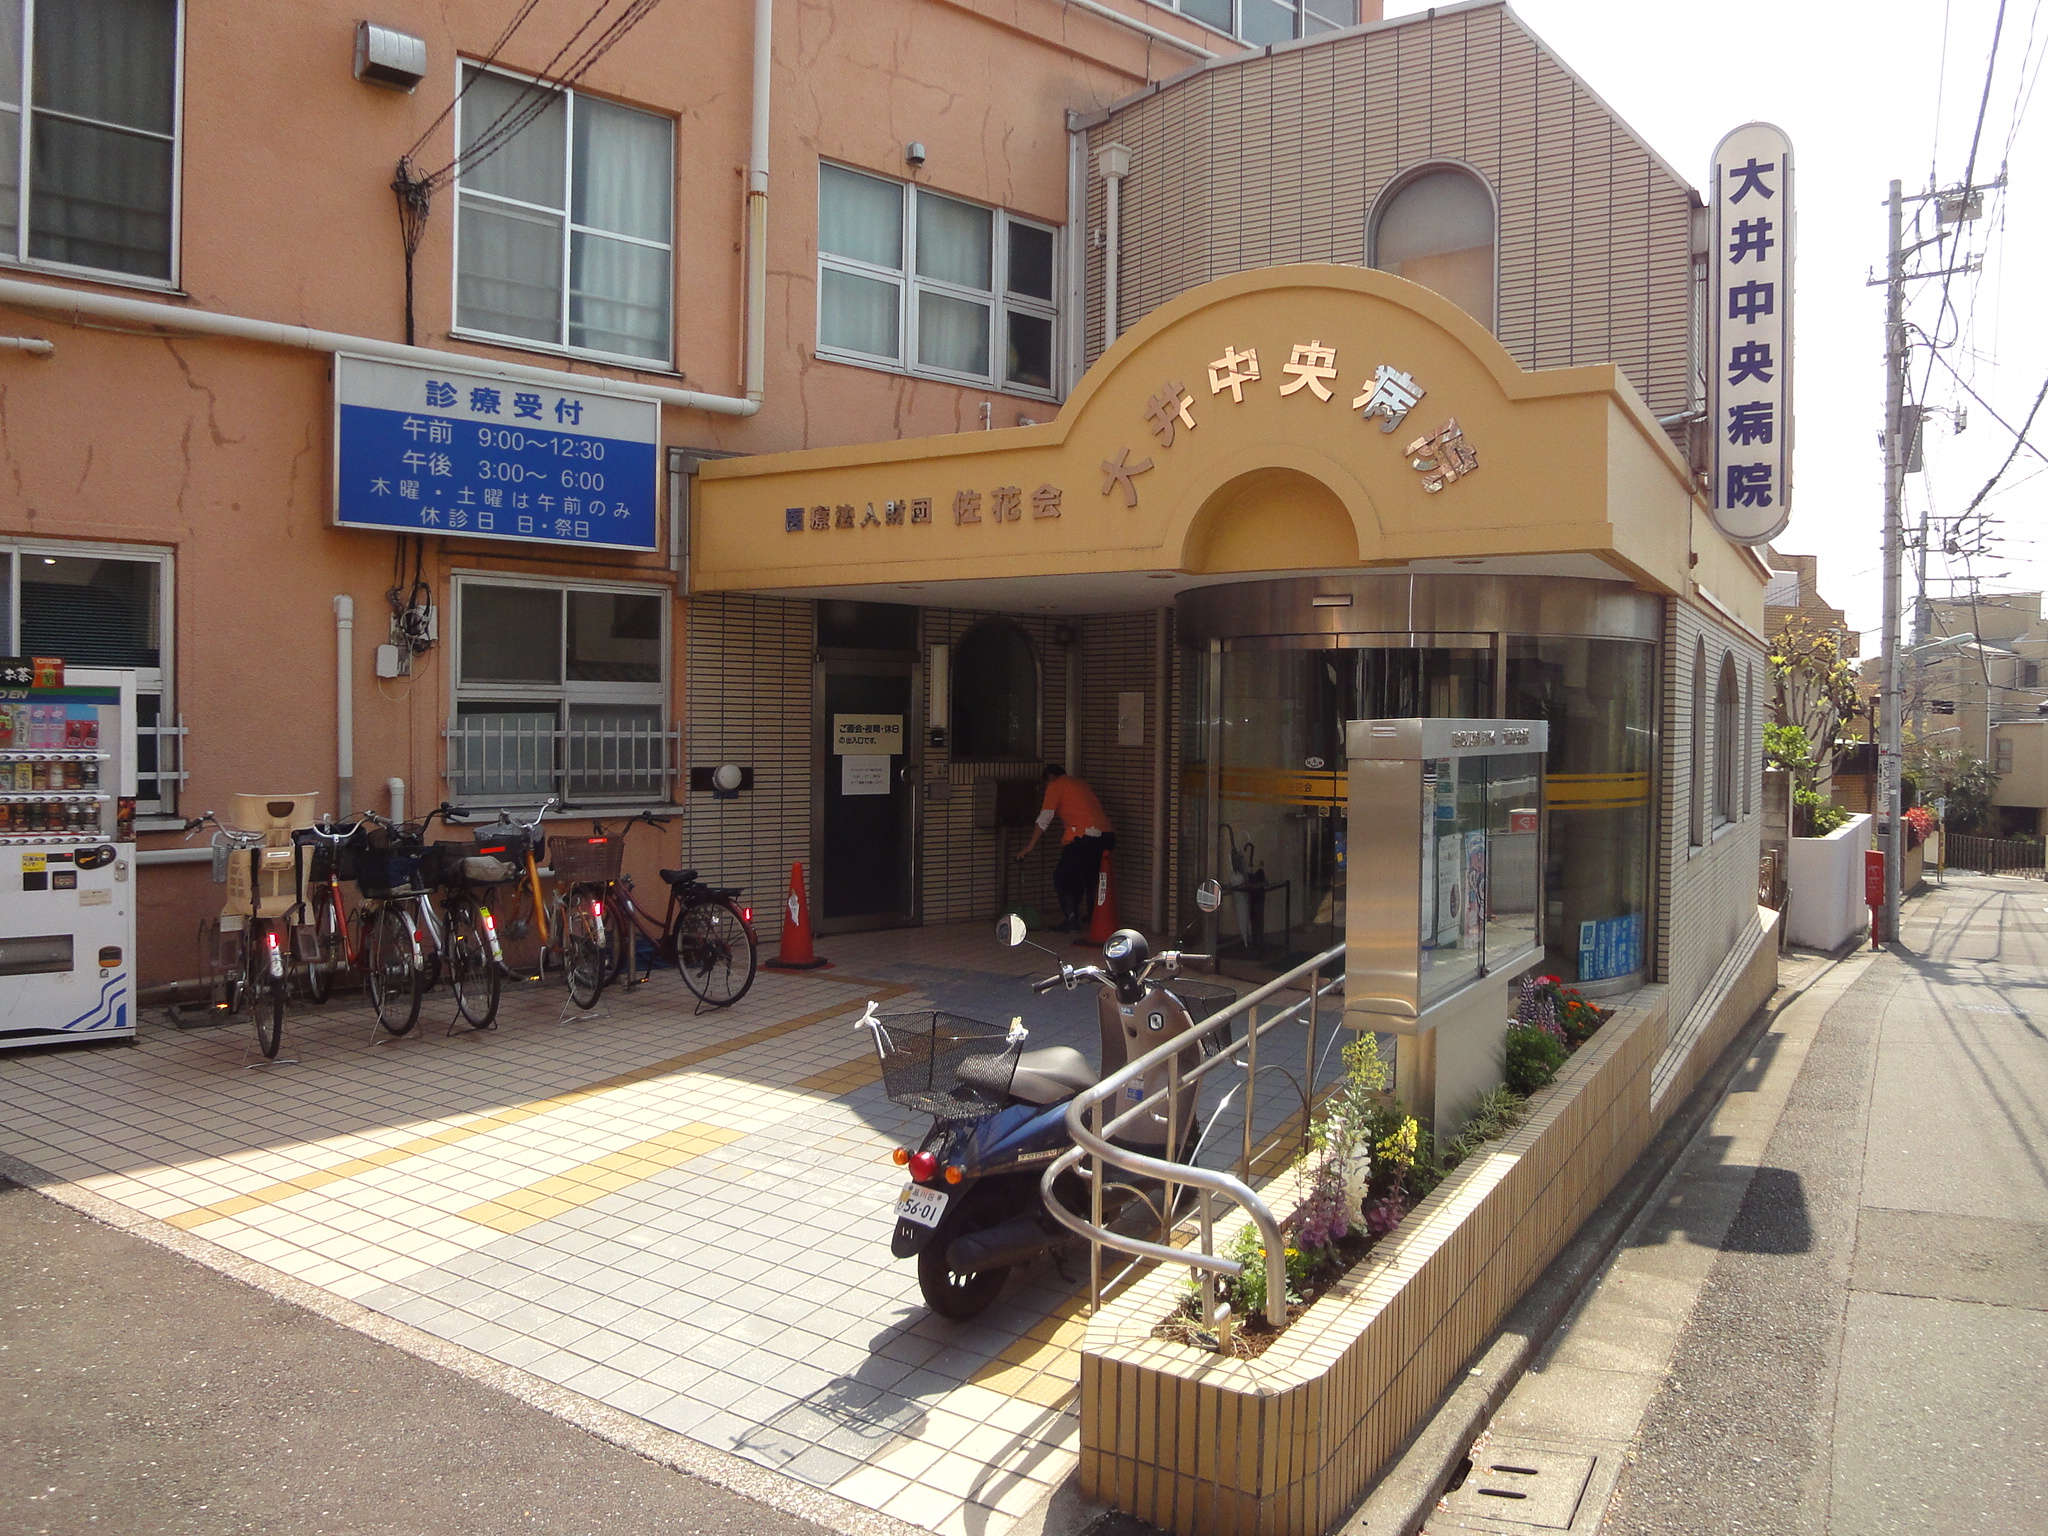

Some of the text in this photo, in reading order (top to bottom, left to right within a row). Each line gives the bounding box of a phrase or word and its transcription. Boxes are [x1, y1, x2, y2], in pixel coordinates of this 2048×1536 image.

[1727, 157, 1774, 509] 大井中央病院
[426, 380, 584, 425] 診療受付
[403, 416, 452, 444] 午前
[1101, 339, 1479, 508] 大井中央病院
[403, 449, 452, 477] 午後
[370, 477, 631, 519] 木曜・土曜は午前のみ
[785, 483, 1062, 532] 医療法人財団 佐花会
[420, 506, 590, 538] 休診日 日・祭日
[0, 667, 33, 682] お茶
[839, 724, 899, 733] ご面会・夜間・休日
[903, 1198, 937, 1221] 56-01
[912, 1188, 935, 1202] 品川区
